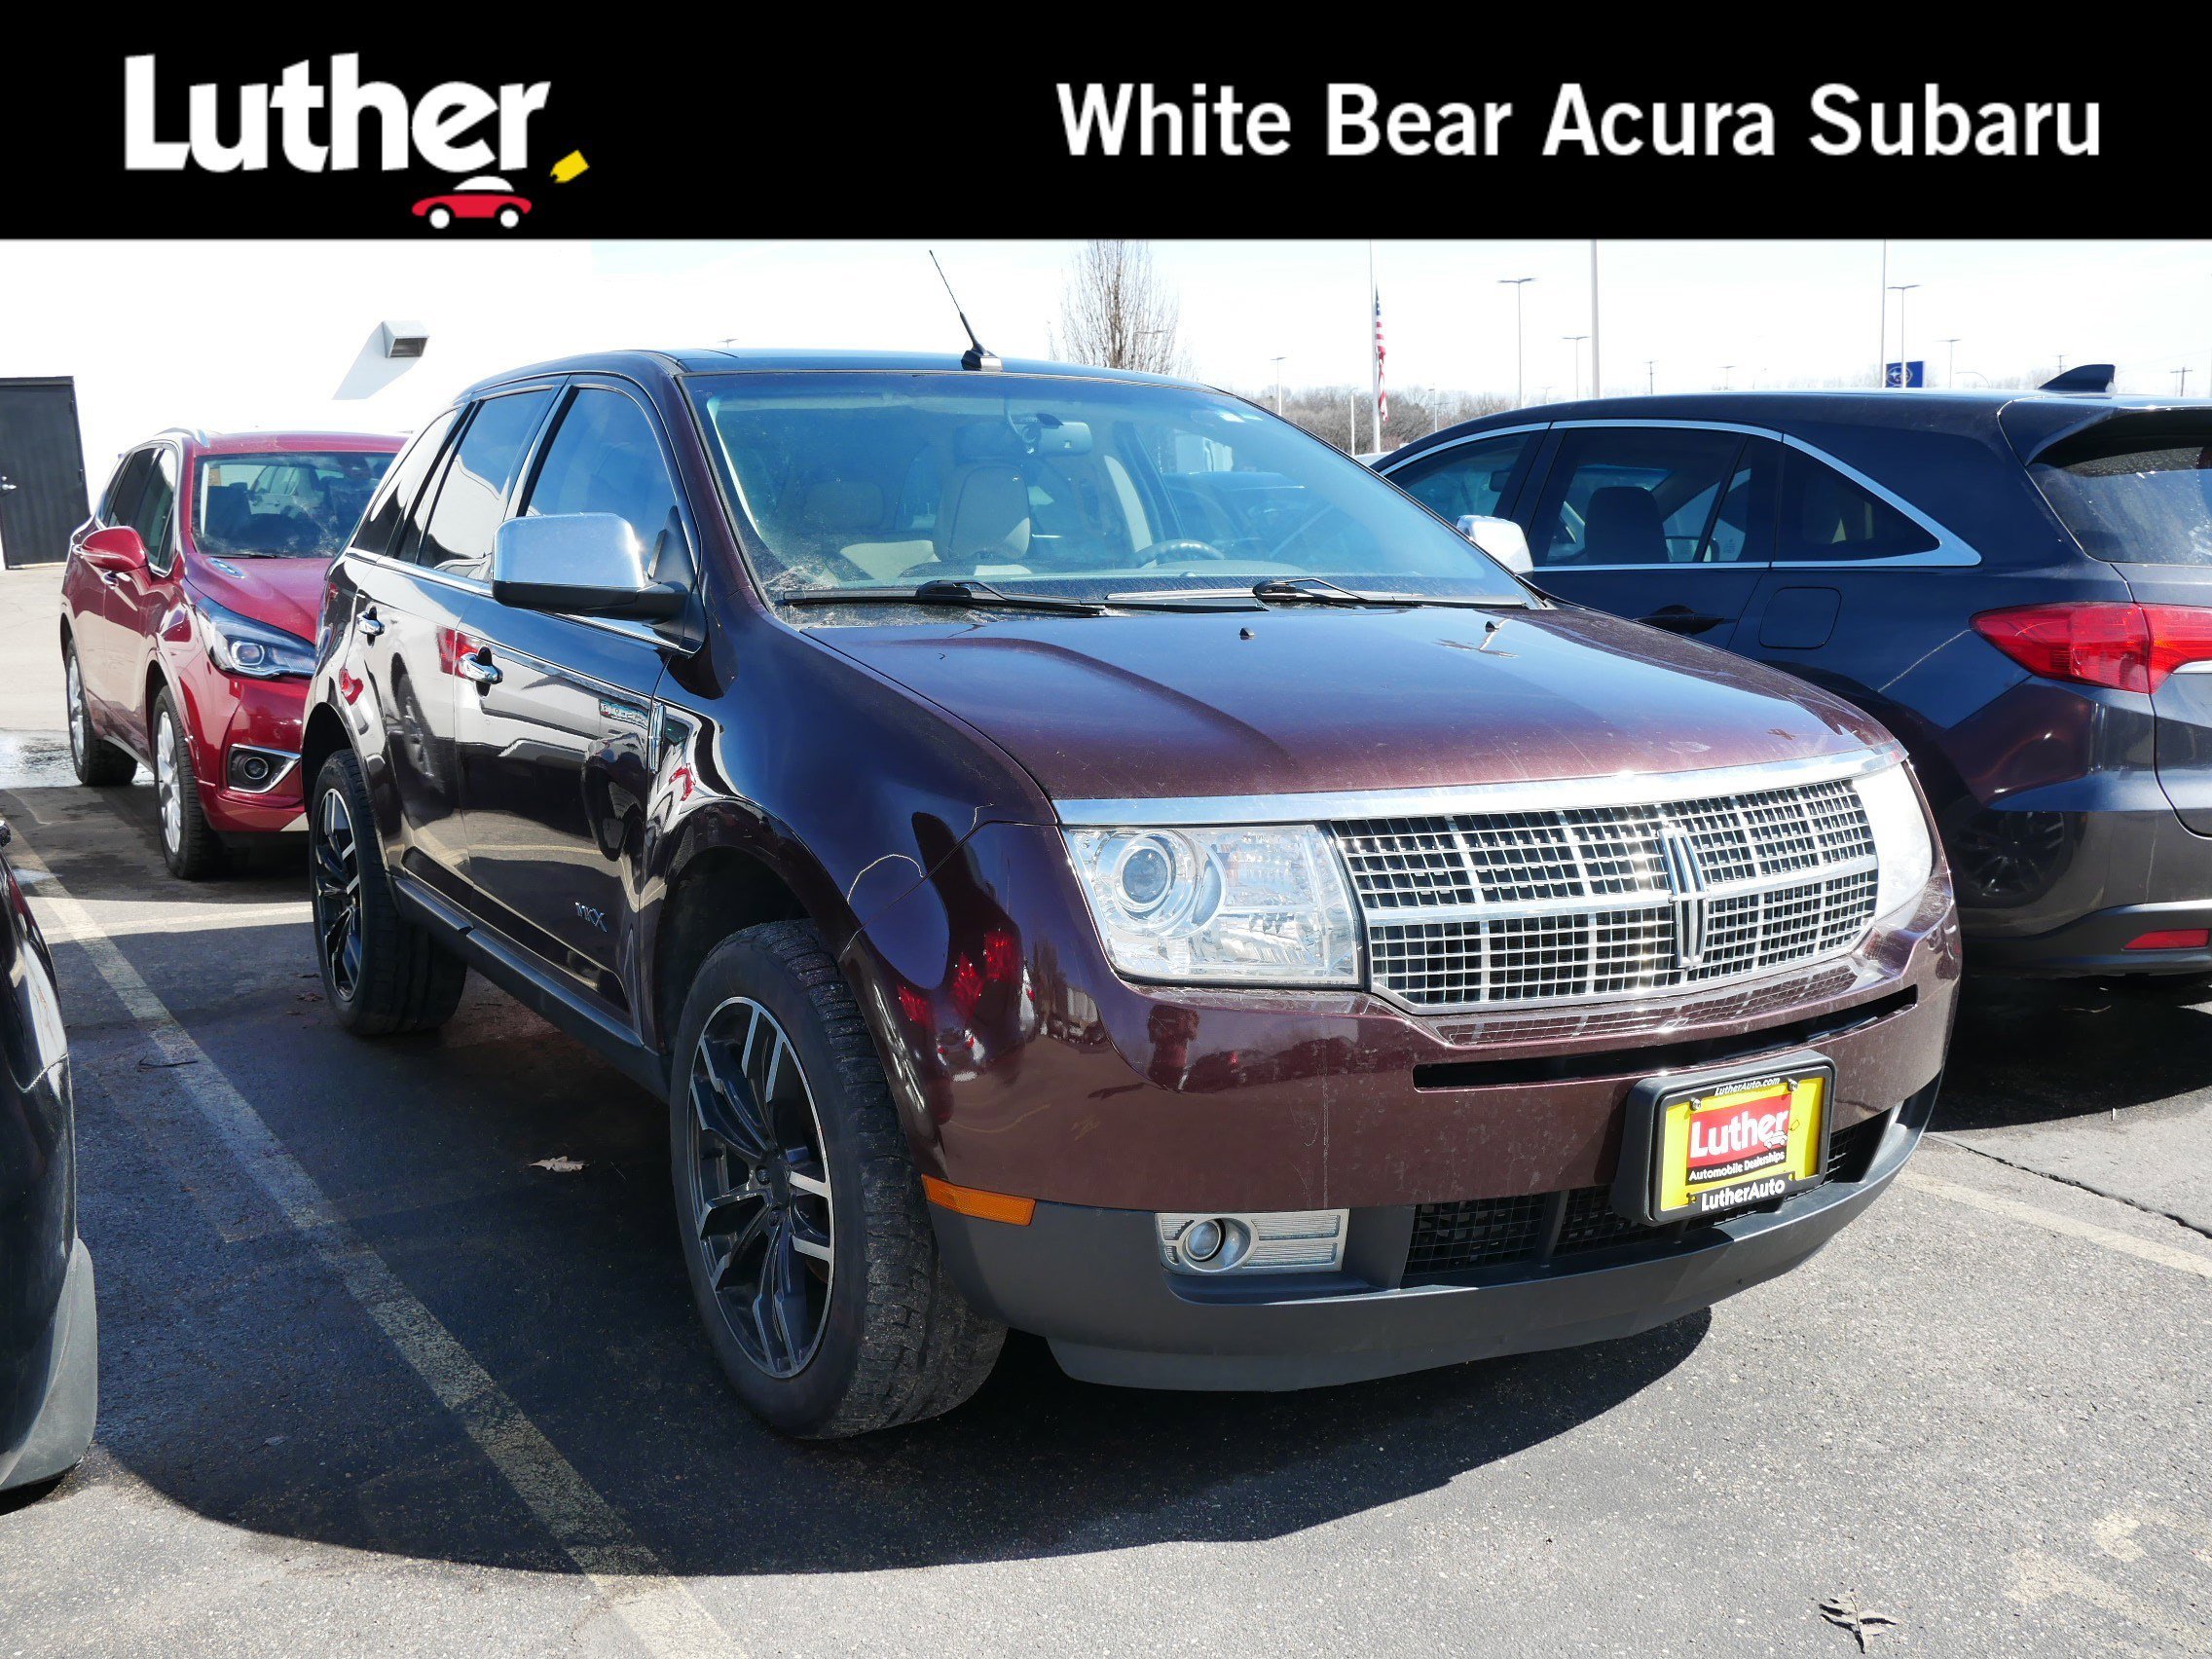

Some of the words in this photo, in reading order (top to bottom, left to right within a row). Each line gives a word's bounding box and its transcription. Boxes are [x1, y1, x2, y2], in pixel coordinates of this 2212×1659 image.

[574, 902, 608, 933] MKX
[1715, 1078, 1780, 1095] LutherAuto.com
[1690, 1110, 1789, 1159] Luther
[1689, 1162, 1743, 1181] Automobile
[1744, 1151, 1785, 1169] Dealerships
[1702, 1179, 1786, 1211] LutherAuto
